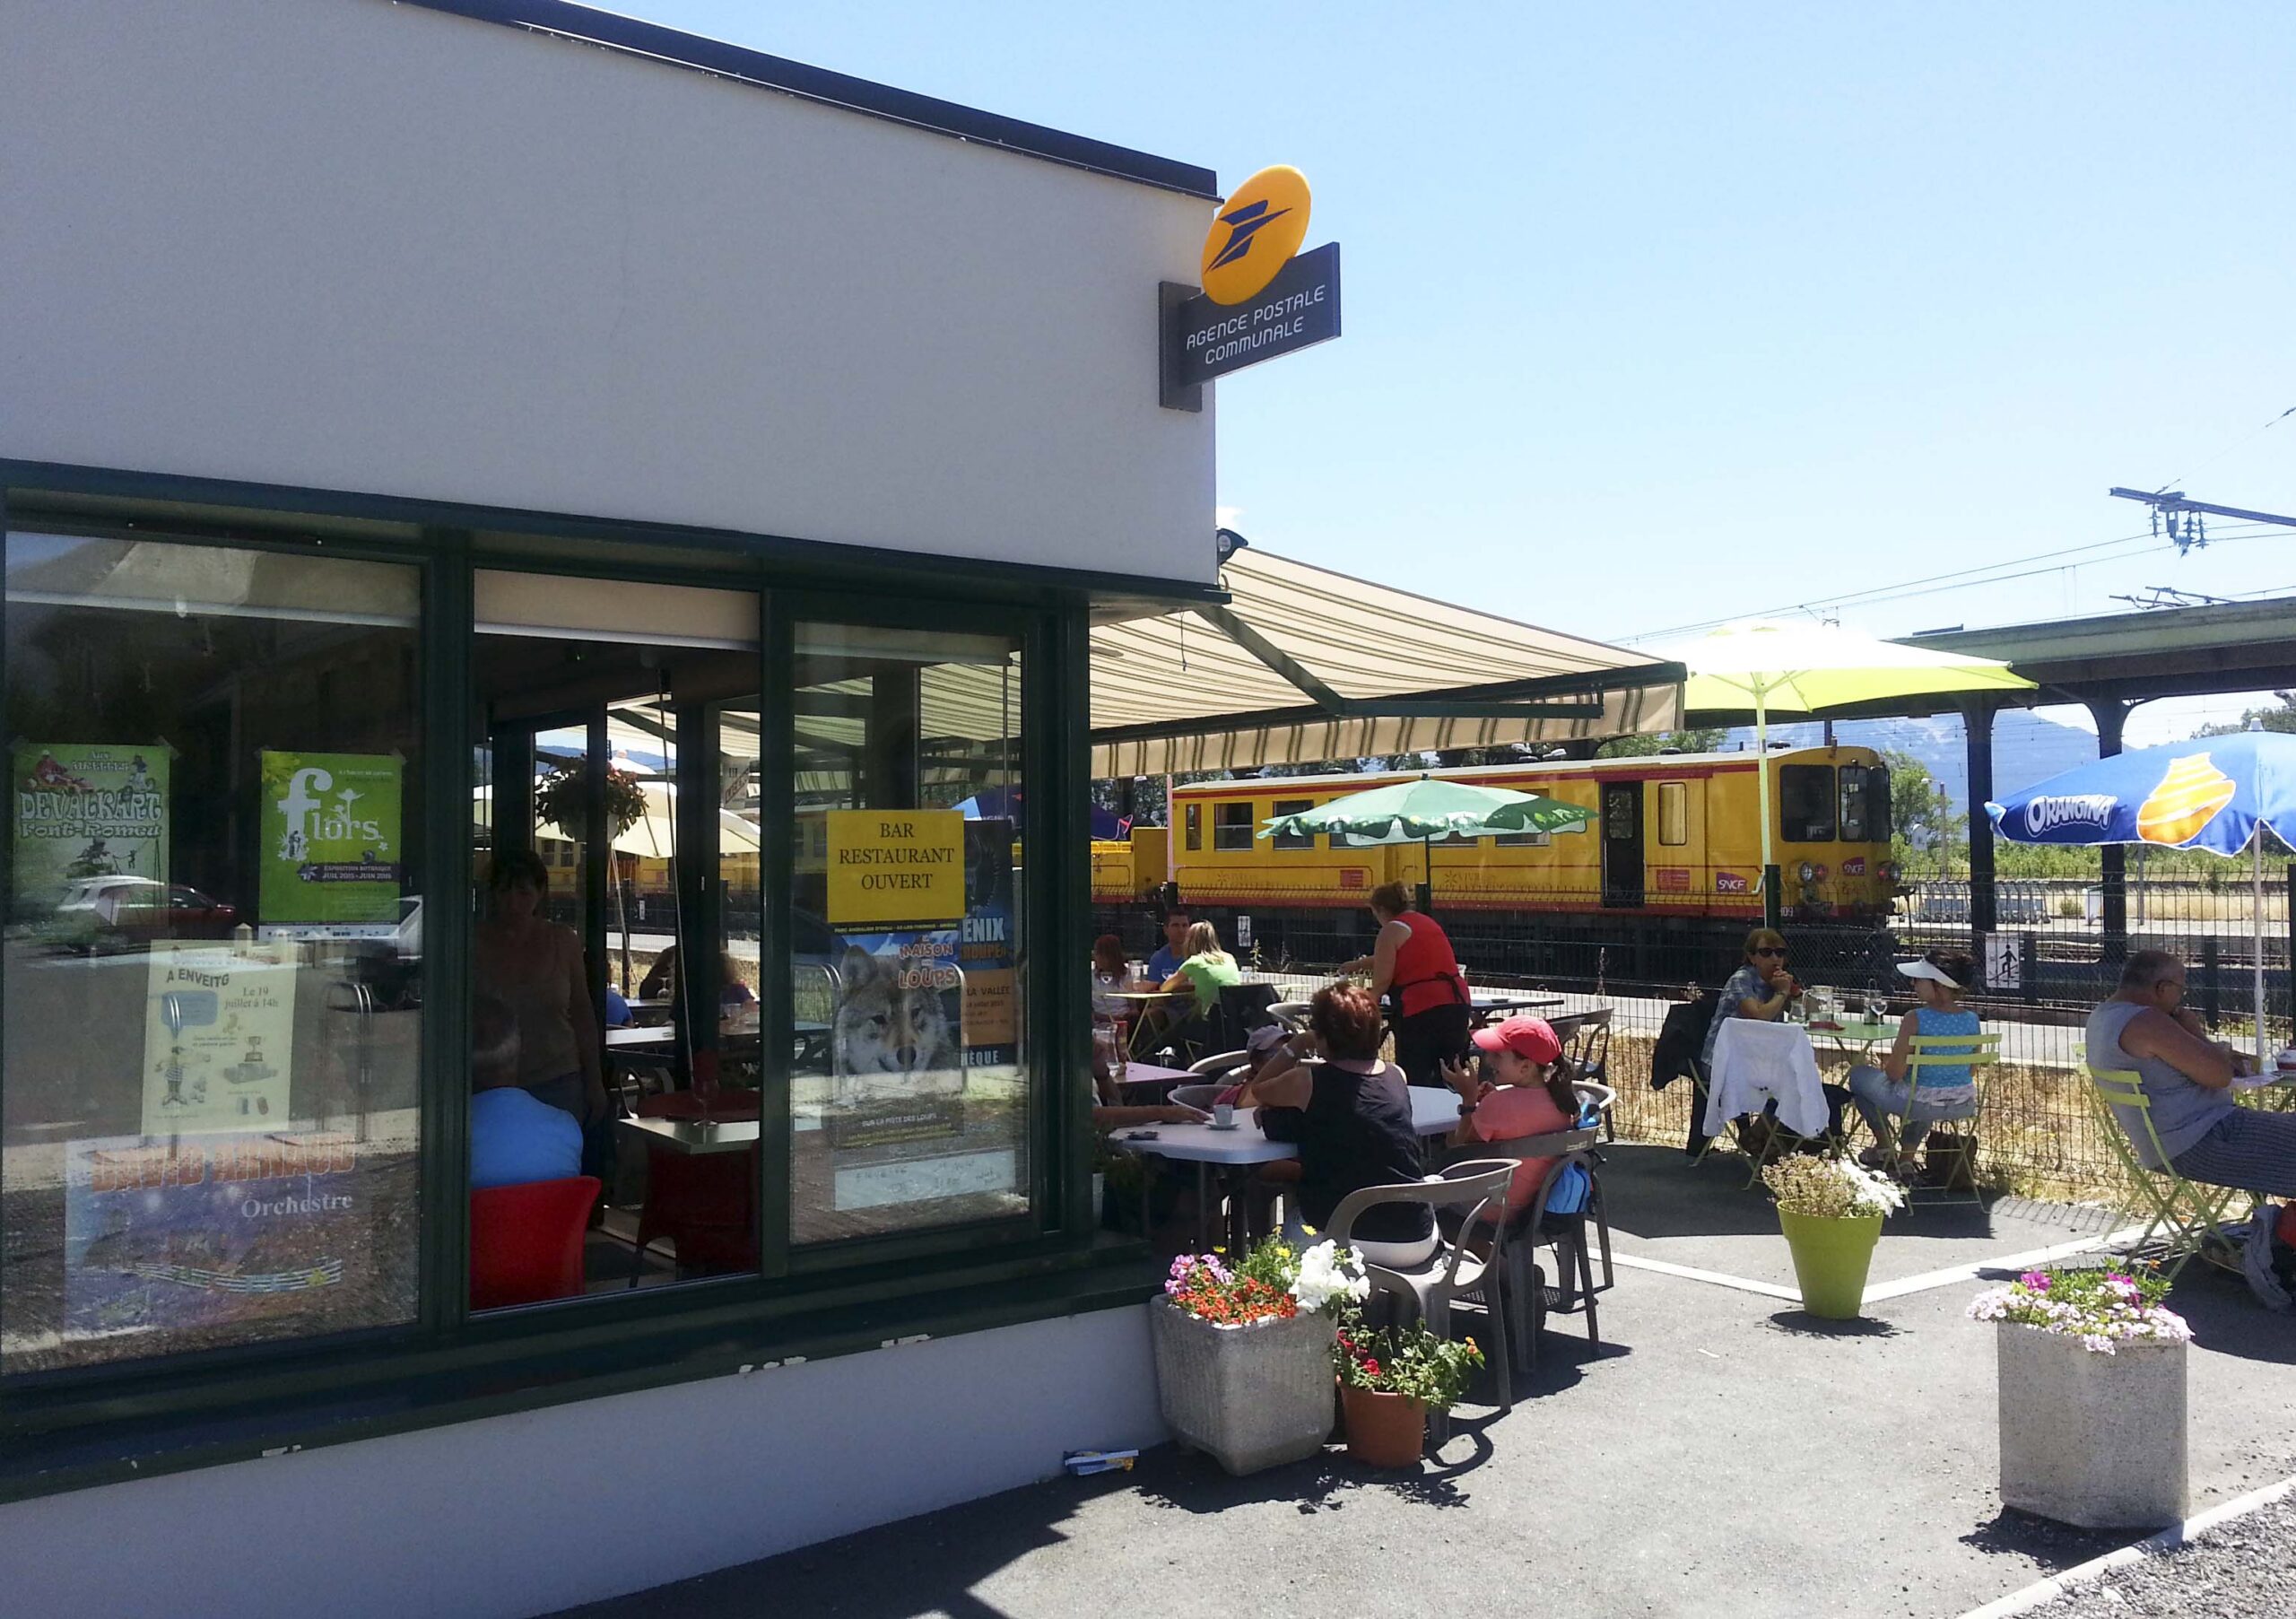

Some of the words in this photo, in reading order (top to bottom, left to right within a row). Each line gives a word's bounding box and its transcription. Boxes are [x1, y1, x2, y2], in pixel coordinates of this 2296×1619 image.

[1187, 314, 1248, 351] AGENCE
[1254, 284, 1326, 326] POSTALE
[1205, 317, 1304, 365] COMMUNALE
[20, 789, 163, 821] DEVALKART
[2026, 795, 2117, 836] ORANGINA
[21, 823, 161, 838] Font-Romeu
[880, 823, 915, 838] BAR
[839, 848, 954, 865] RESTAURANT
[1844, 864, 1864, 874] SNCF
[861, 874, 933, 890] OUVERT
[1718, 879, 1746, 890] SNCF
[900, 943, 953, 960] MAISON
[178, 969, 230, 987] ENVEITG
[898, 968, 955, 989] LOUPS
[243, 988, 256, 997] Le
[225, 997, 252, 1009] juillet
[263, 999, 279, 1007] 14h
[240, 1193, 353, 1218] Orchestre
